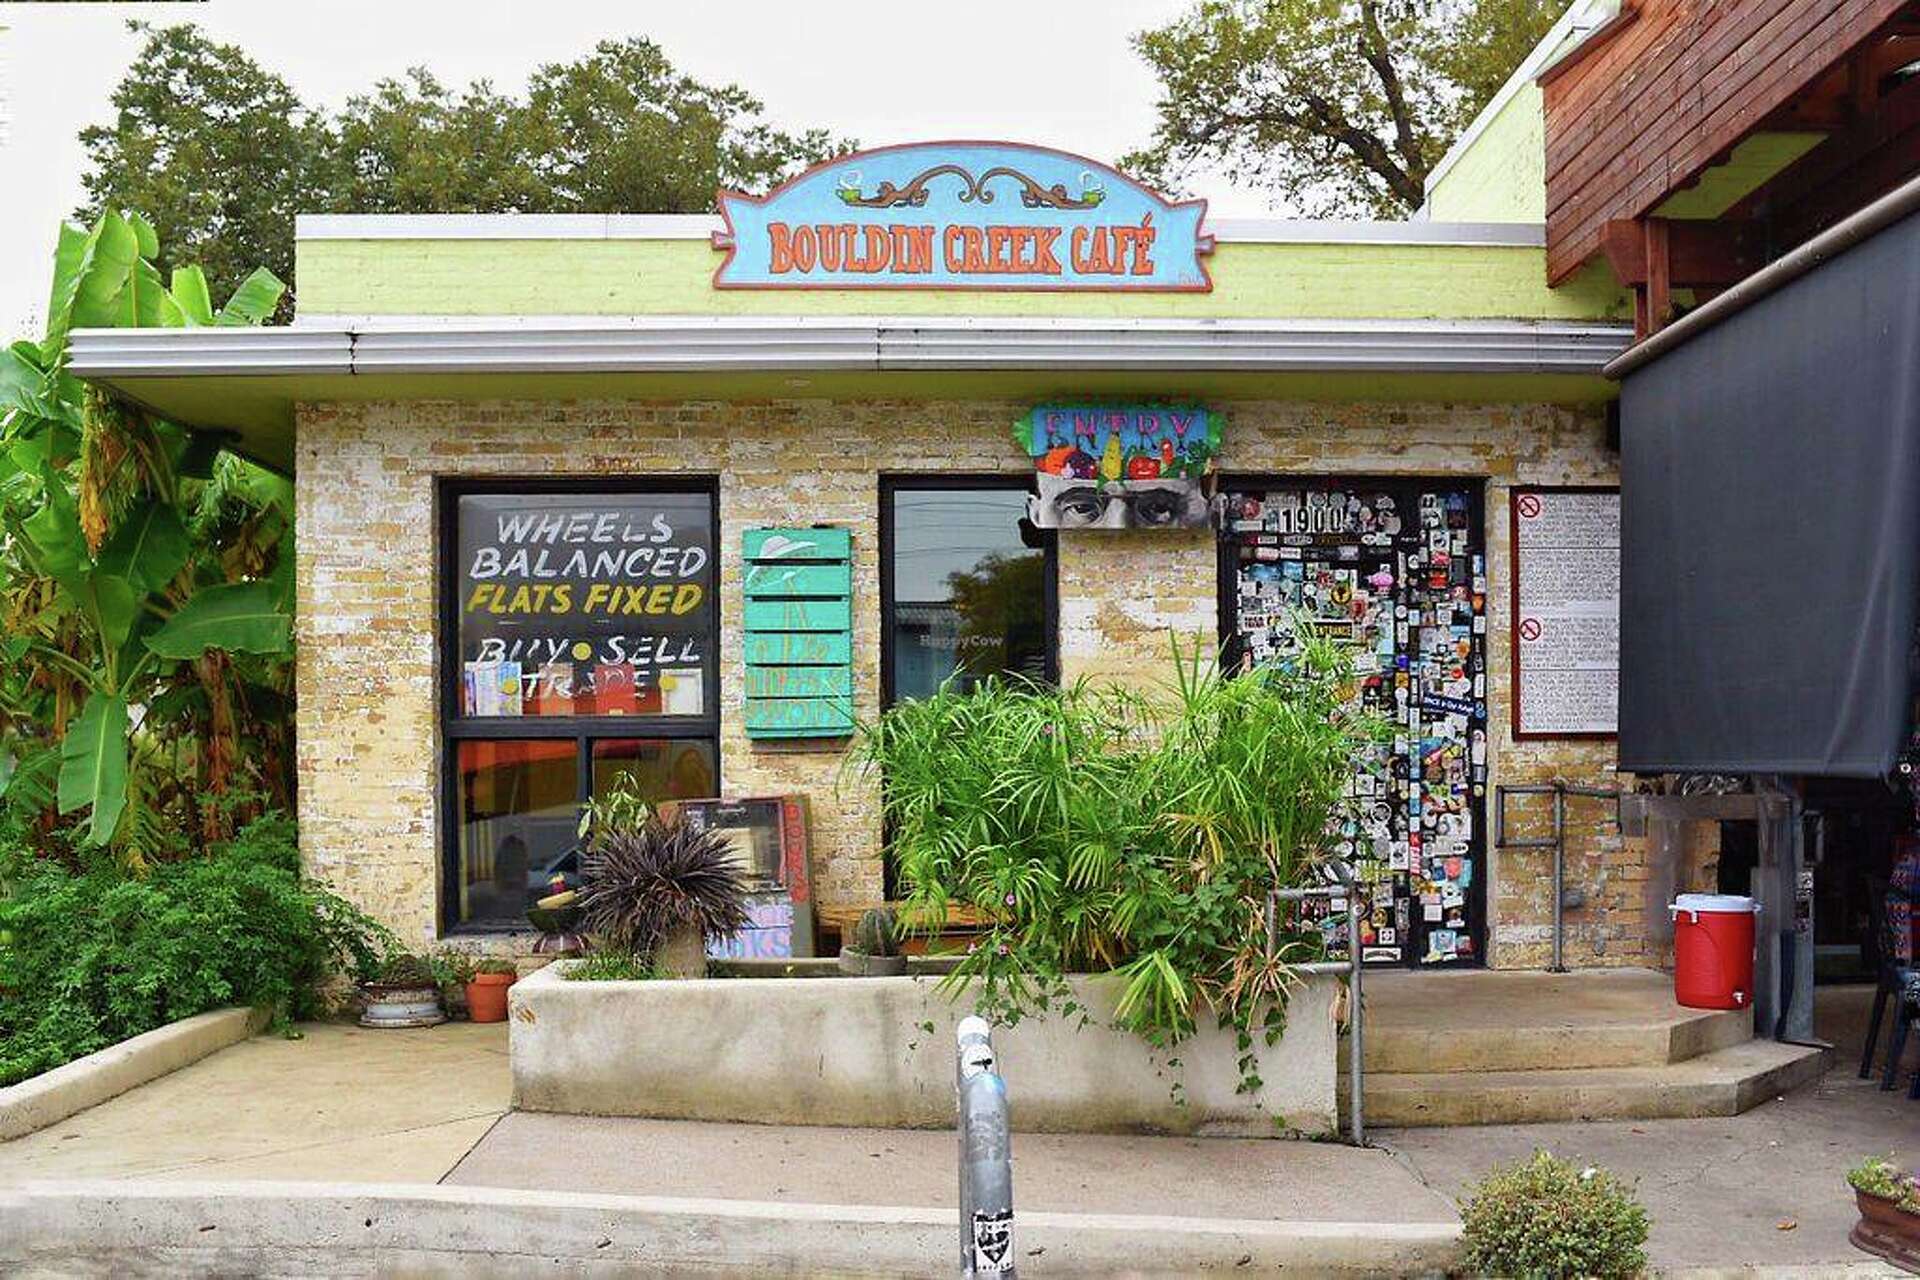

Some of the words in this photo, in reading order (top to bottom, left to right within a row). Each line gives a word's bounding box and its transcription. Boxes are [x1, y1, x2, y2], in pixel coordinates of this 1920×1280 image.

[768, 223, 935, 274] BOULDIN
[943, 224, 1063, 275] CREEK
[1071, 211, 1157, 275] CAFÉ
[498, 512, 673, 545] WHEELS
[469, 546, 708, 579] BALANCED
[465, 583, 573, 616] FLATS
[583, 583, 704, 616] FIXED
[474, 637, 570, 668] BUY
[600, 636, 701, 664] SELL
